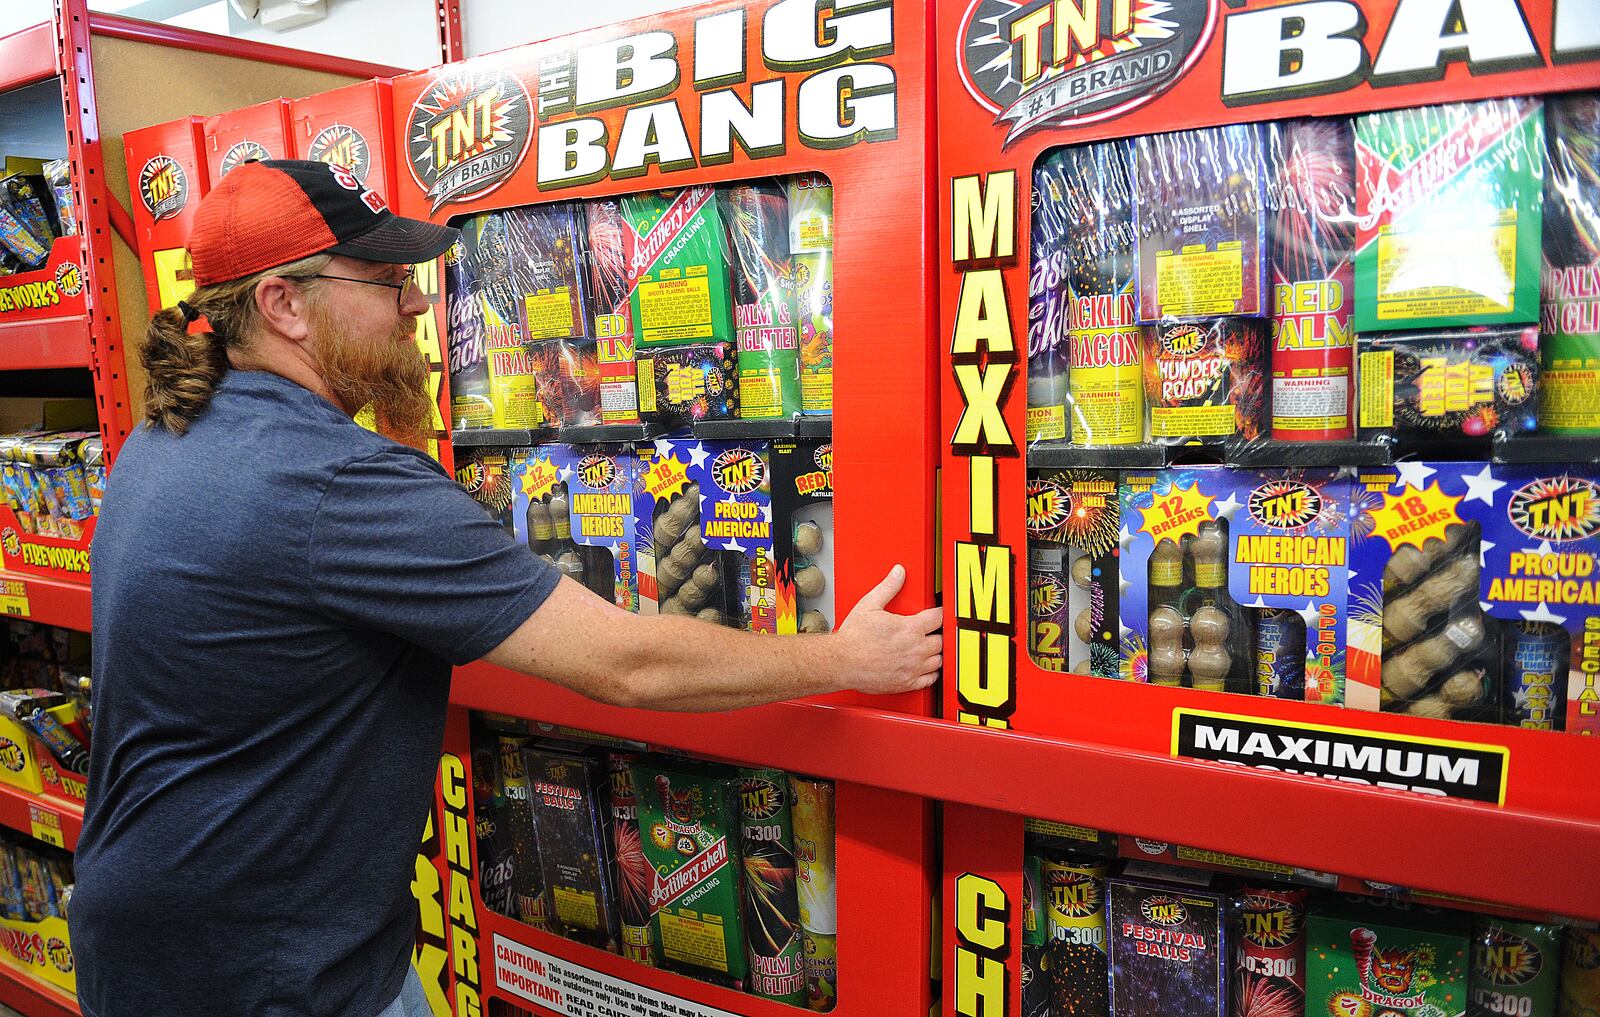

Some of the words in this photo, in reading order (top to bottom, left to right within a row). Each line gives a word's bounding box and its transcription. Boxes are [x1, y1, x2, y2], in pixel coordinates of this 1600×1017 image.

[575, 0, 895, 114] BIG
[1028, 86, 1058, 117] #1
[1069, 50, 1172, 98] BRAND
[430, 86, 499, 172] TNT
[536, 62, 898, 192] BANG
[441, 172, 457, 194] #1
[461, 151, 513, 183] BRAND
[149, 173, 176, 203] TNT
[1178, 204, 1220, 216] ASSORTED
[1179, 213, 1213, 226] DISPLAY
[663, 215, 706, 265] CRACKLING
[1183, 224, 1209, 233] SHELL
[61, 269, 77, 291] TNT
[659, 280, 688, 289] WARNING
[1274, 281, 1343, 314] RED
[737, 302, 773, 327] PALM
[778, 302, 791, 324] &
[744, 327, 798, 352] GLITTER
[1171, 330, 1199, 350] TNT
[1162, 380, 1208, 401] ROAD
[1284, 379, 1331, 387] WARNING
[1420, 357, 1446, 416] NEED
[1445, 360, 1470, 410] YOU
[950, 169, 1016, 728] MAXIMU
[456, 463, 475, 484] TNT
[526, 473, 555, 495] BREAKS
[530, 465, 545, 482] 12
[584, 461, 609, 482] TNT
[652, 472, 685, 495] BREAKS
[653, 463, 672, 483] 18
[722, 457, 753, 486] TNT
[795, 471, 826, 495] RED
[1073, 481, 1115, 493] ARTILLERY
[1366, 483, 1390, 492] BLAST
[573, 493, 631, 515] AMERICAN
[715, 502, 757, 519] PROUD
[1082, 496, 1106, 507] SHELL
[1159, 496, 1187, 518] 12
[1263, 491, 1306, 520] TNT
[1390, 496, 1428, 521] 18
[1529, 490, 1591, 530] TNT
[581, 515, 624, 537] HEROES
[705, 521, 769, 538] AMERICAN
[1152, 507, 1205, 536] BREAKS
[1385, 508, 1451, 540] BREAKS
[21, 542, 90, 573] FIREWORKS
[1235, 535, 1346, 566] AMERICAN
[1510, 552, 1594, 577] PROUD
[755, 547, 769, 617] SPECIAL
[1249, 566, 1331, 597] HEROES
[1316, 604, 1337, 694] SPECIAL
[1580, 616, 1600, 716] SPECIAL
[1194, 724, 1479, 786] MAXIMUM
[534, 782, 582, 799] FESTIVAL
[543, 795, 574, 810] BALLS
[667, 820, 701, 834] DRAGON
[650, 860, 700, 905] Artillery
[700, 840, 728, 873] shell
[682, 877, 721, 907] CRACKLING
[1052, 881, 1092, 907] TNT
[678, 917, 705, 929] WARNING
[1150, 903, 1177, 919] TNT
[1243, 909, 1288, 934] TNT
[1122, 922, 1207, 950] FESTIVAL
[1136, 941, 1192, 963] BALLS
[753, 954, 790, 976] PALM
[497, 944, 547, 977] CAUTION:
[547, 962, 562, 975] This
[563, 968, 603, 990] assortment
[604, 982, 636, 1000] contains
[637, 993, 659, 1009] items
[660, 1001, 678, 1014] that
[498, 966, 563, 1006] IMPORTANT:
[566, 992, 595, 1011] READ
[548, 974, 562, 987] Use
[562, 980, 595, 998] outdoors
[614, 998, 629, 1010] Use
[630, 1004, 647, 1017] only
[1361, 986, 1426, 1008] DRAGON
[566, 1003, 584, 1016] ON
